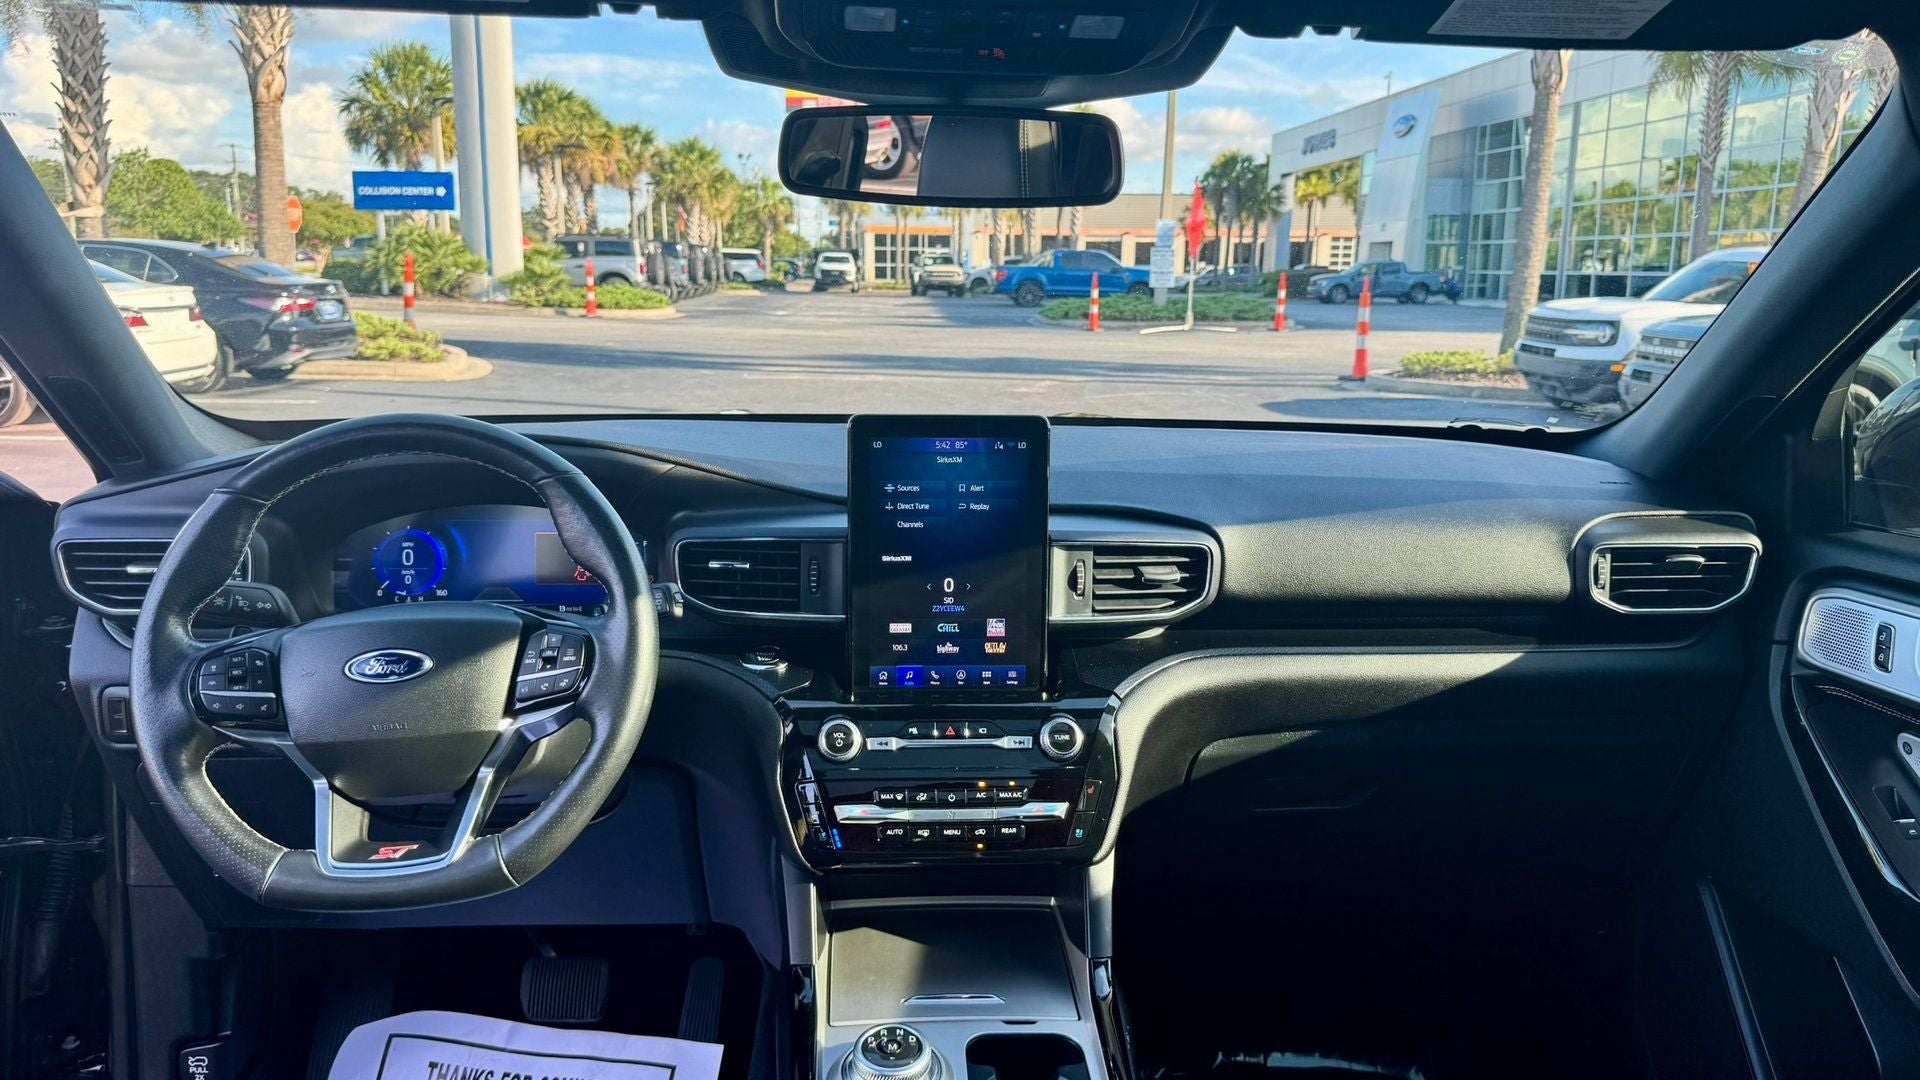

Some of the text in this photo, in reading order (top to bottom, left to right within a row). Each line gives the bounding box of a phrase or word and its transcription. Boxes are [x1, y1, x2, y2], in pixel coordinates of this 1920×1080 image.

[358, 186, 434, 196] COLLISION CENTER
[873, 441, 882, 449] LO
[935, 441, 951, 449] 5:42
[1018, 441, 1027, 449] LO
[937, 456, 963, 464] SiriusXM
[897, 502, 930, 510] Direct Tune
[970, 502, 990, 511] Replay
[897, 520, 924, 528] Channels
[402, 549, 414, 566] 0
[404, 575, 412, 585] 0
[943, 577, 954, 593] 0
[937, 623, 960, 633] CHILL
[892, 644, 908, 652] 106.3
[366, 656, 408, 675] Ford
[368, 844, 420, 861] ST
[888, 1043, 898, 1051] M
[189, 1066, 209, 1074] PULL
[428, 1060, 495, 1080] THANKS
